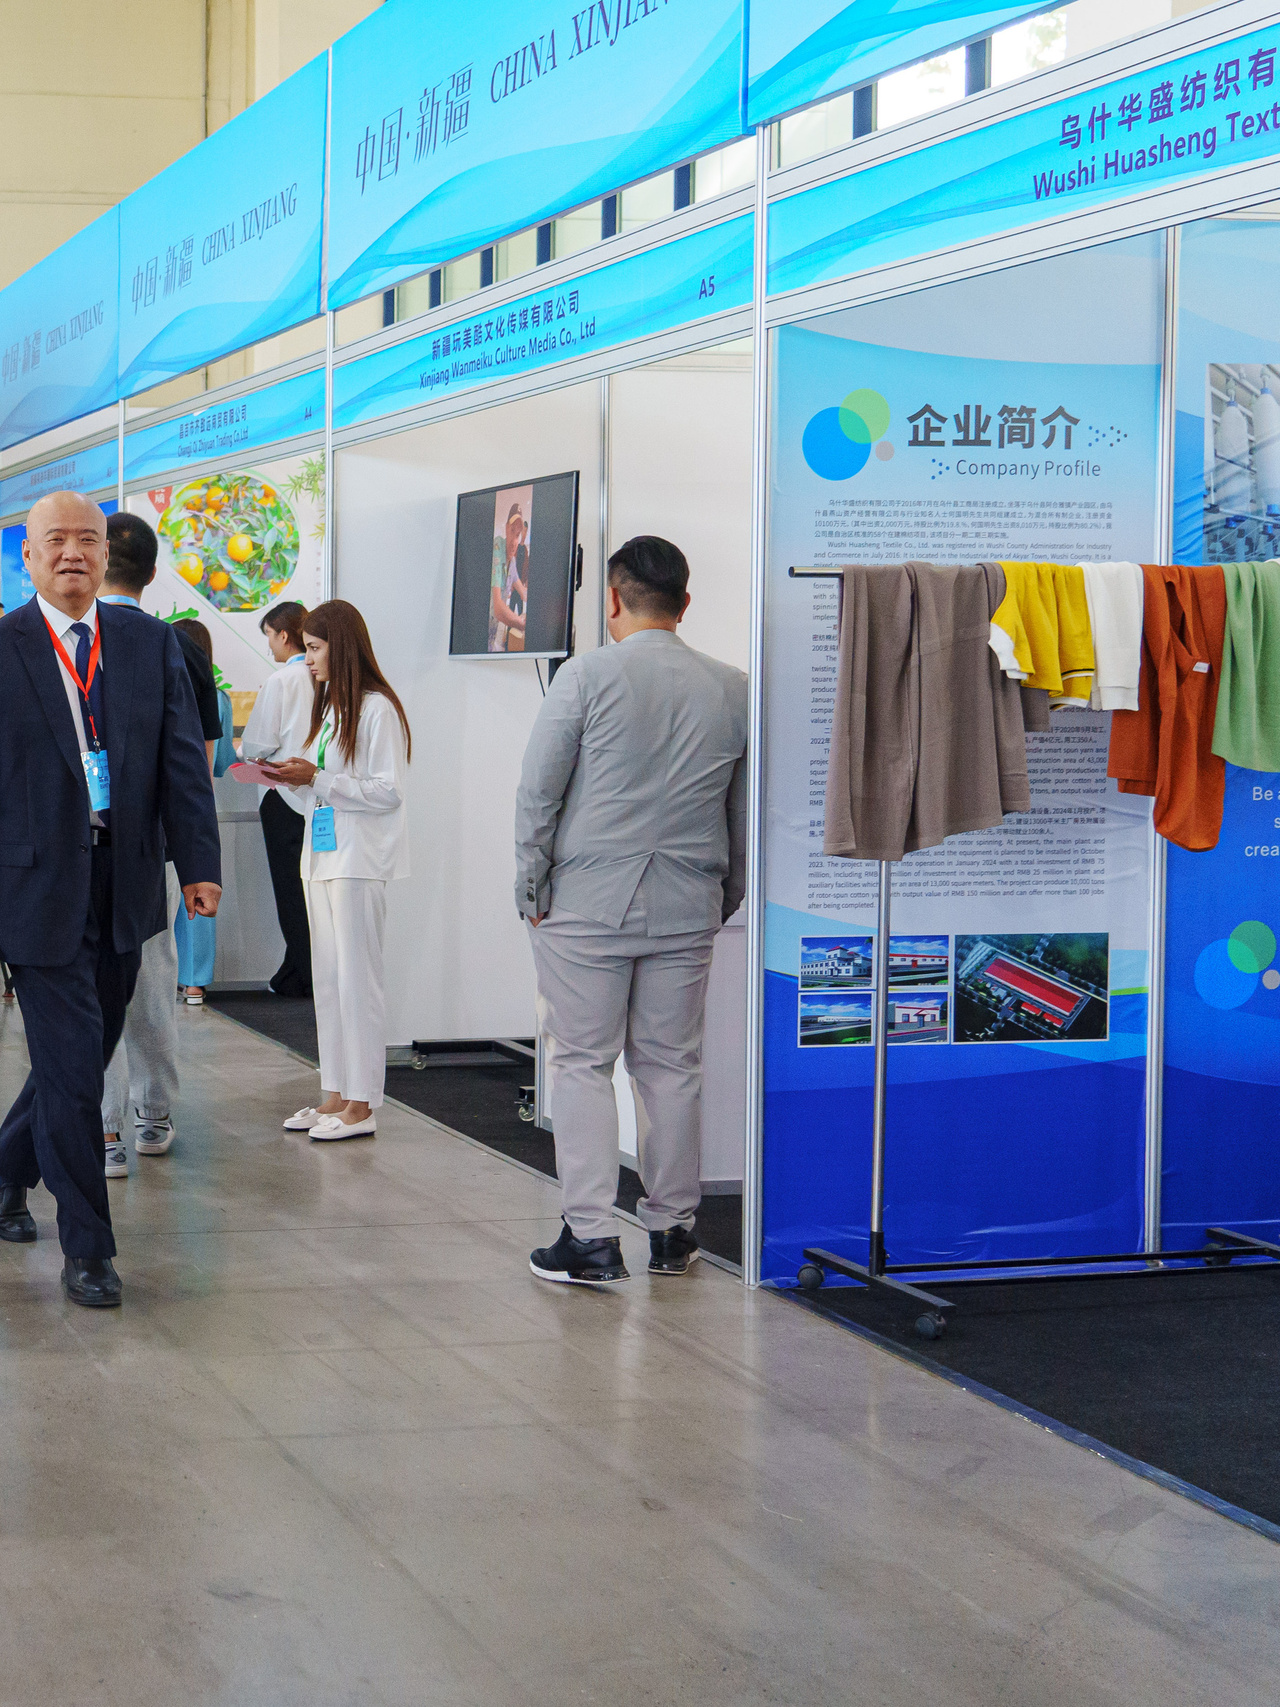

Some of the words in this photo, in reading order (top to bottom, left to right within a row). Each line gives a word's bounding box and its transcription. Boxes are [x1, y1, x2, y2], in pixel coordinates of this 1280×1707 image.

[490, 28, 557, 103] CHINA
[1059, 47, 1279, 150] 乌什华盛纺织有
[1033, 154, 1095, 200] Wushi
[1104, 126, 1217, 180] Huasheng
[202, 220, 236, 266] CHINA
[240, 183, 298, 245] XINJIANG
[699, 275, 716, 301] A5
[419, 368, 449, 390] Xinjiang
[452, 351, 493, 377] Wanmeiku
[495, 344, 526, 365] Culture
[529, 332, 557, 356] Media
[580, 316, 596, 340] Ltd
[431, 289, 579, 361] 新疆玩美酷文化传媒有限公司
[906, 403, 1082, 451] 企业简介
[956, 459, 1040, 480] Company
[1045, 460, 1102, 478] Profile
[1252, 786, 1274, 801] Be
